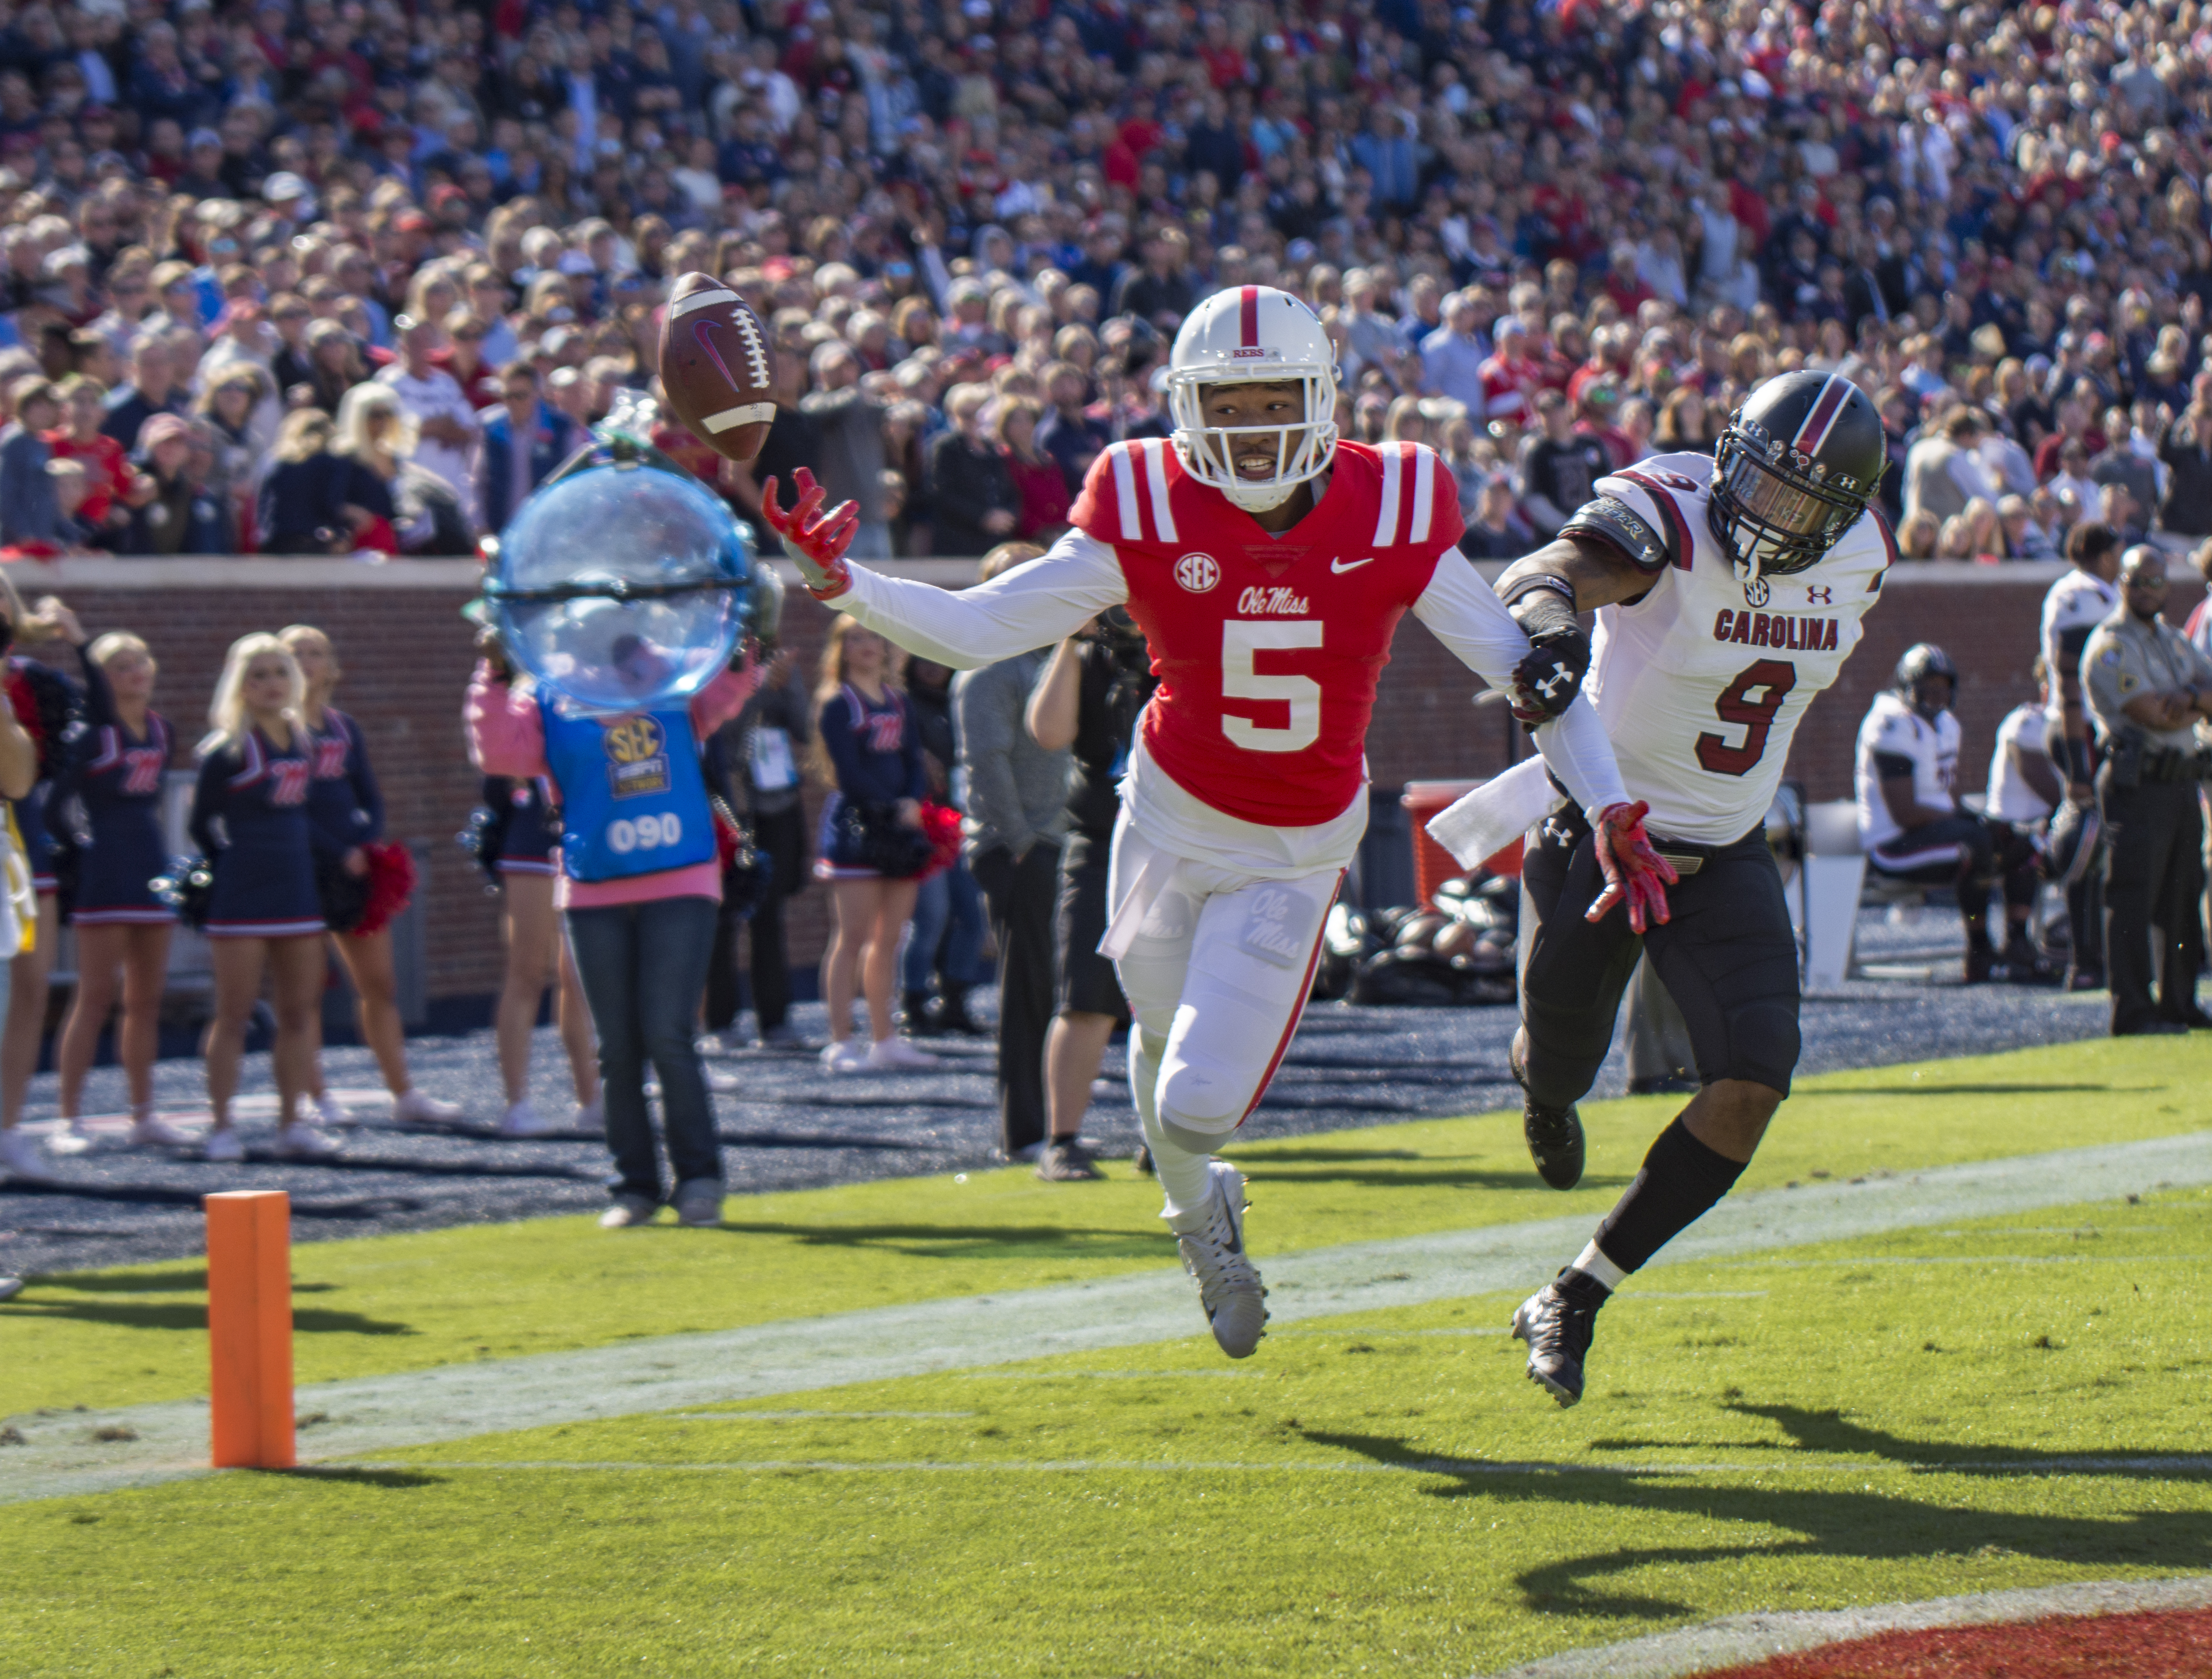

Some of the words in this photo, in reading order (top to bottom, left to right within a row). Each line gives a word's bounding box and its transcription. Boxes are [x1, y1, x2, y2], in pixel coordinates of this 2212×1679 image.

[1233, 349, 1264, 358] REBS
[1592, 503, 1644, 540] GEAR
[1178, 555, 1216, 590] SEC
[1744, 578, 1770, 606] SEC
[1237, 586, 1267, 615] Ole
[1266, 586, 1309, 615] Miss
[1713, 608, 1839, 651] CAROLINA
[1222, 619, 1323, 752] 5
[1693, 657, 1798, 777] 9
[610, 717, 661, 762] SEC
[608, 812, 682, 854] 090
[1251, 888, 1289, 921] Ole
[1247, 917, 1301, 959] Miss
